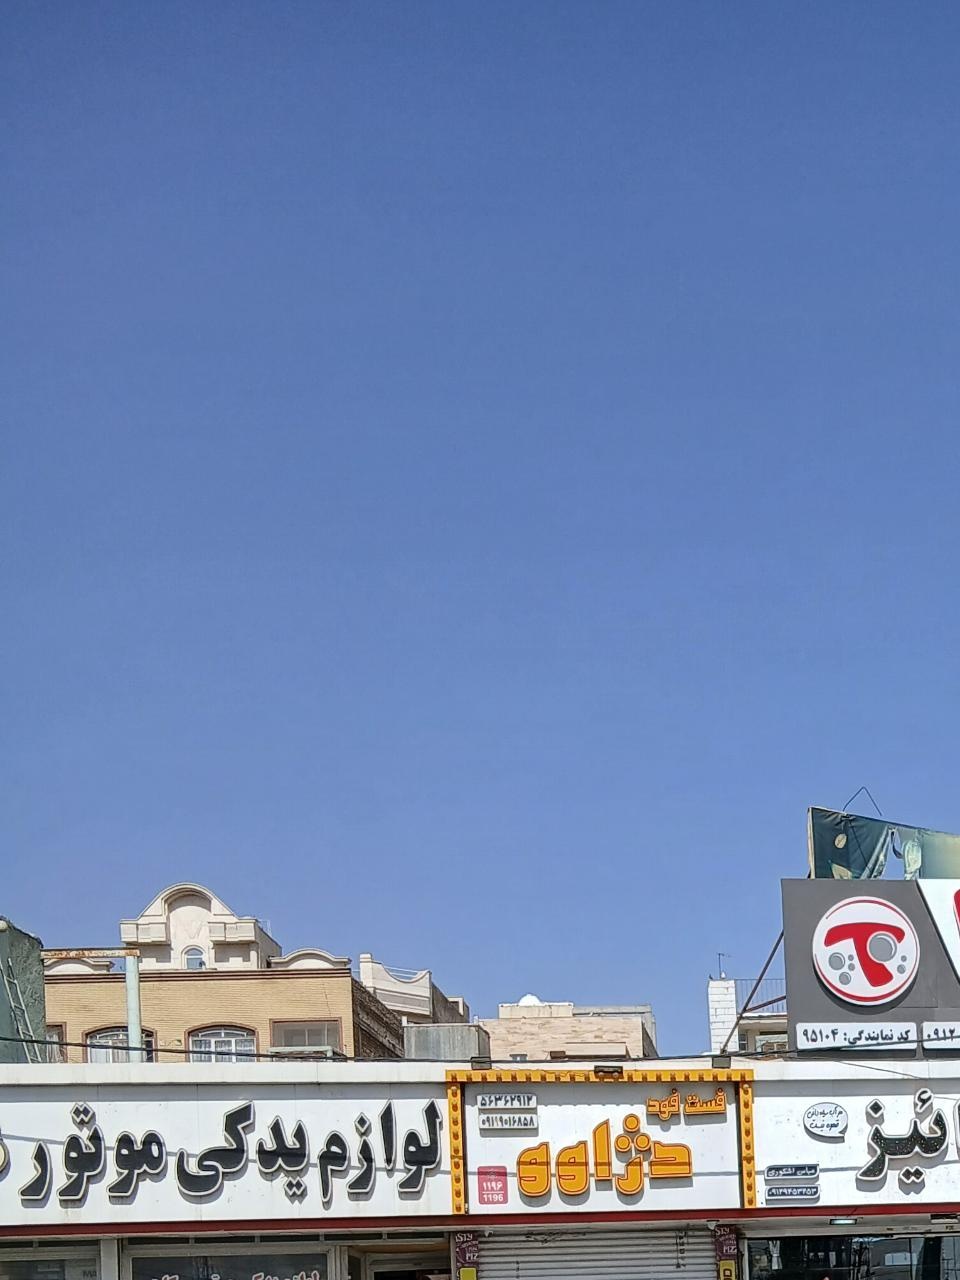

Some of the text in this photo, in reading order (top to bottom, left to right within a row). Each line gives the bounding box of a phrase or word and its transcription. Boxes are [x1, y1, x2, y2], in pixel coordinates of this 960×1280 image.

[897, 1029, 911, 1041] کد
[177, 1099, 309, 1199] یدکی
[647, 1088, 727, 1121] فست فود
[18, 1102, 167, 1200] موتور
[318, 1099, 442, 1202] لوازم
[517, 1113, 692, 1197] دژاوو
